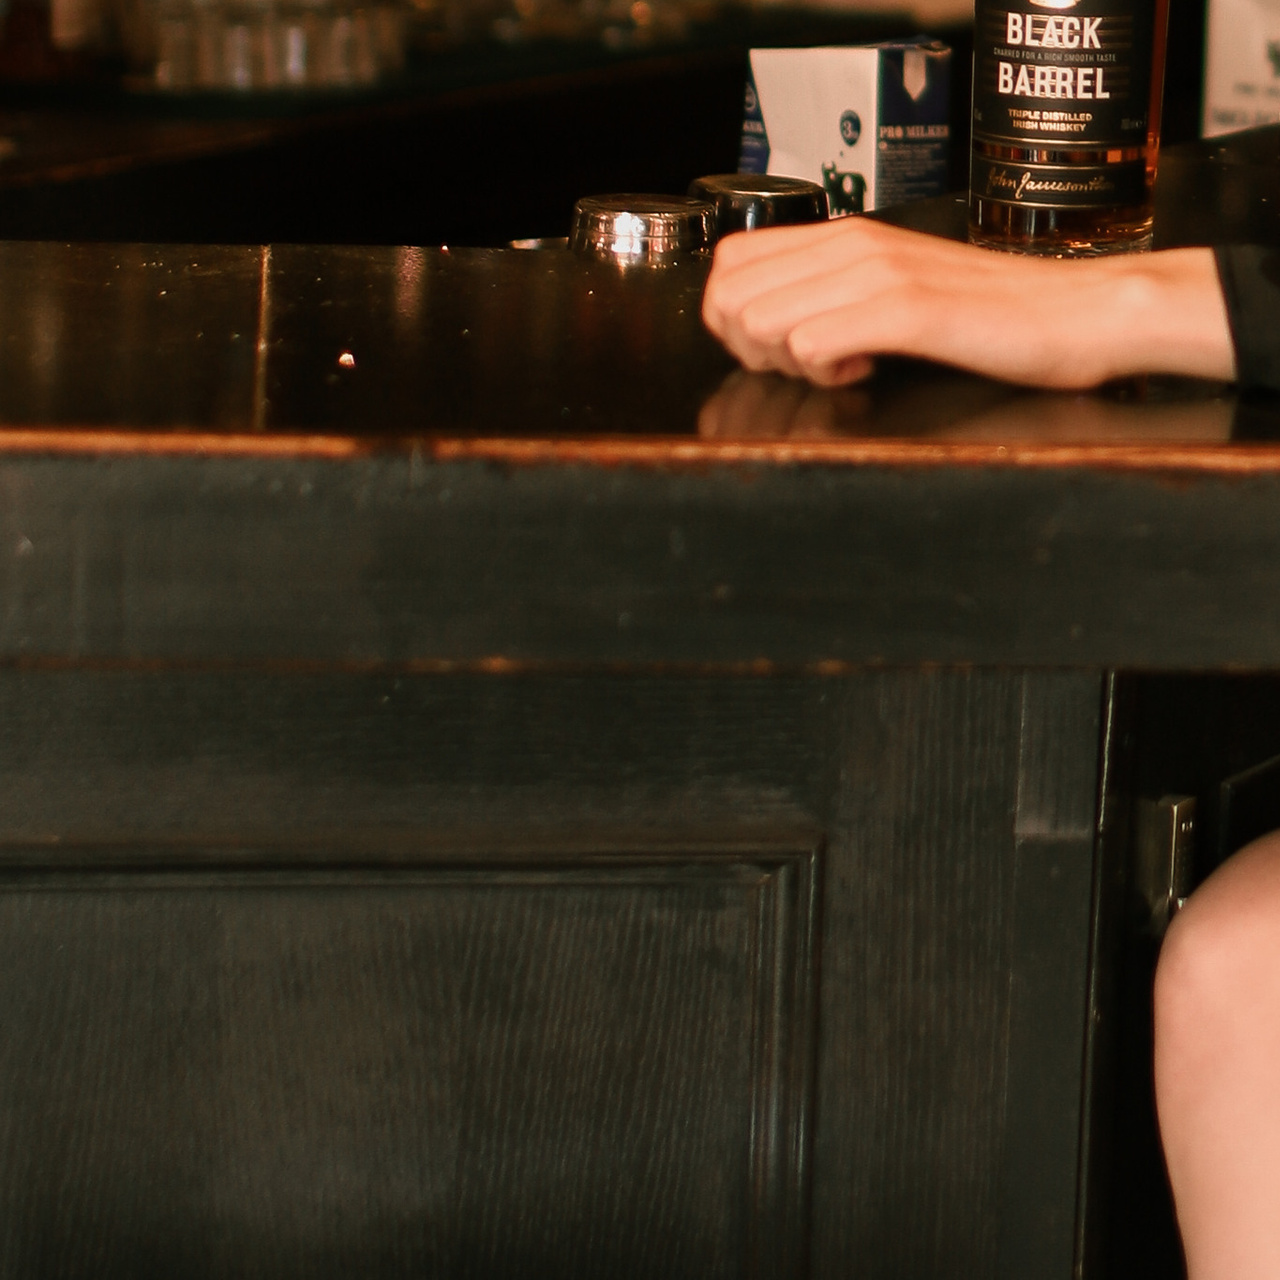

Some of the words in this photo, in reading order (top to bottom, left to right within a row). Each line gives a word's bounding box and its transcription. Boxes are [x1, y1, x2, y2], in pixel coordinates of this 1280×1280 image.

[1006, 12, 1103, 49] BLACK
[998, 61, 1111, 99] BARREL
[1008, 108, 1041, 120] TRIPLE
[1042, 111, 1093, 122] DISTILLED
[1012, 120, 1039, 130] IRISH
[1039, 121, 1087, 132] WHISKEY
